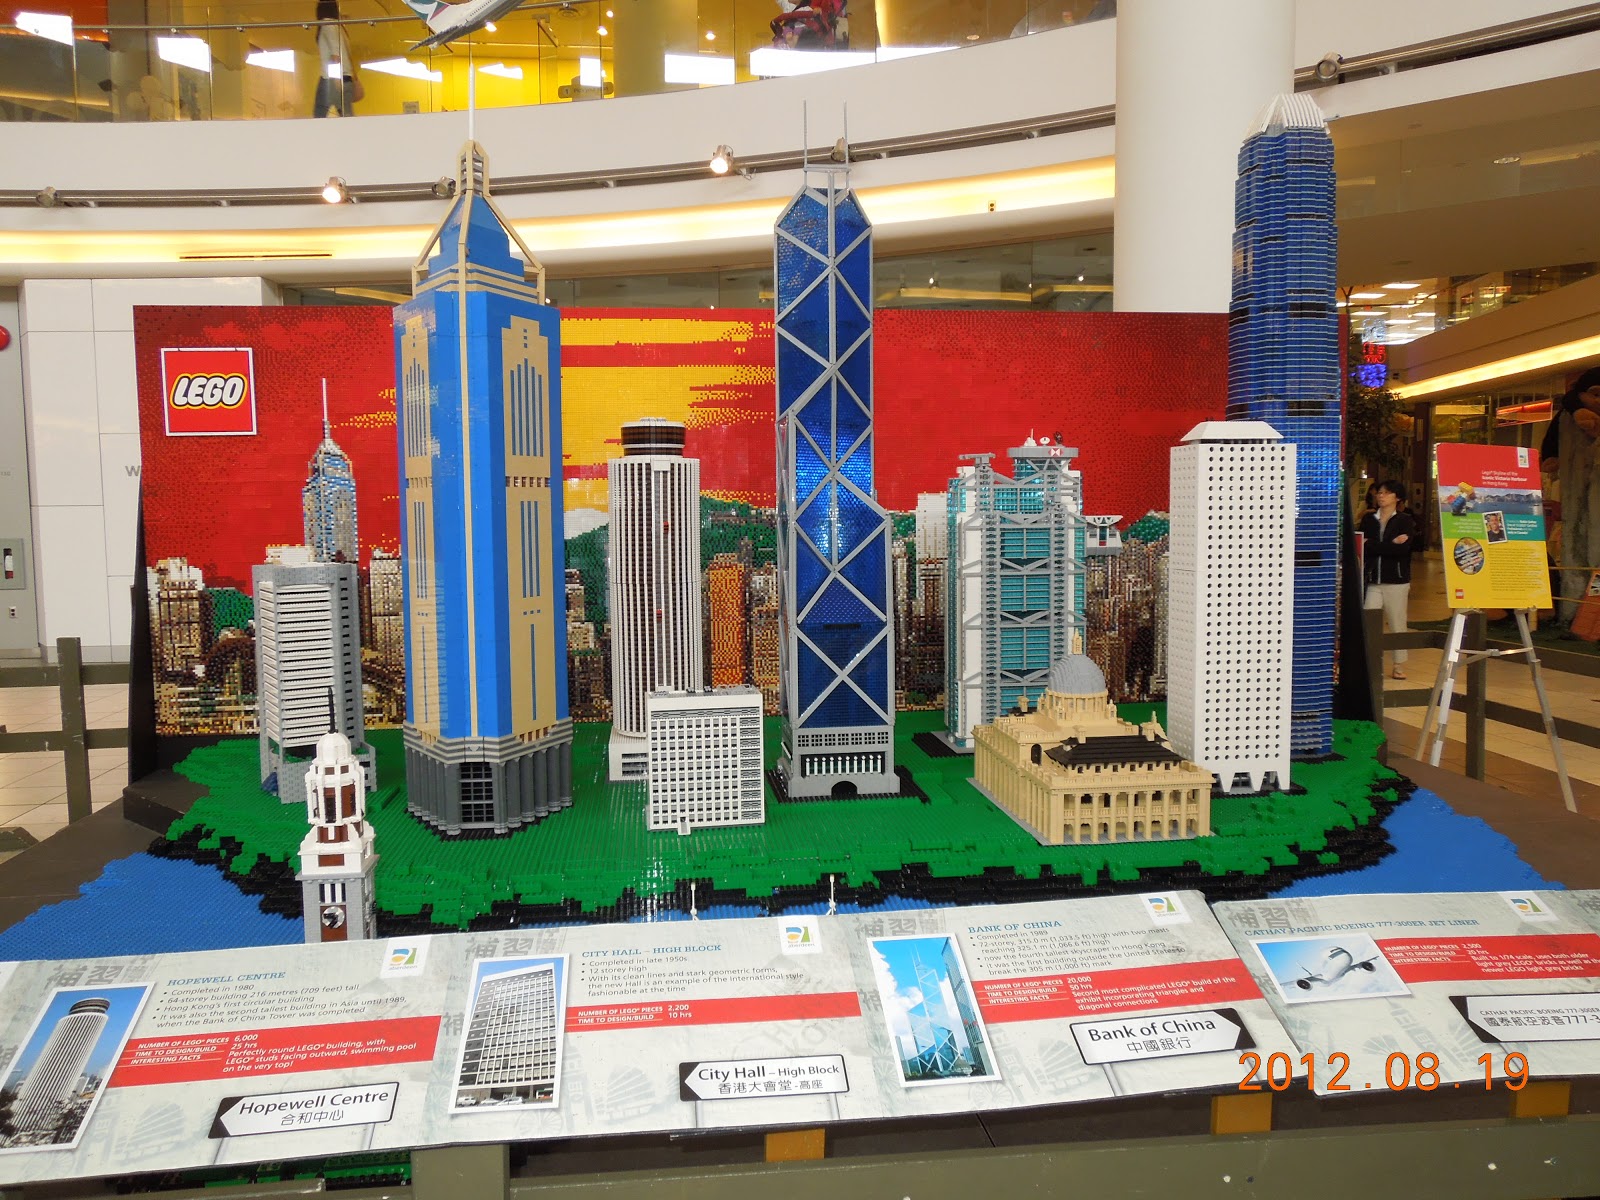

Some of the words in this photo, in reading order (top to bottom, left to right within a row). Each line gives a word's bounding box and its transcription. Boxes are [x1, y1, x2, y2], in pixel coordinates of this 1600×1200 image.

[171, 374, 247, 409] LEGO
[968, 925, 1001, 933] BANK
[1023, 920, 1062, 929] CHINA
[1244, 928, 1287, 936] CATHAY
[1289, 925, 1333, 934] PACIFIC
[1334, 922, 1375, 930] BOEING
[976, 931, 1019, 940] Completed
[582, 950, 609, 958] CITY
[612, 949, 642, 957] HALL
[652, 946, 682, 954] HIGH
[685, 945, 721, 953] BLOCK
[589, 959, 634, 968] Completed
[601, 966, 627, 975] storey
[628, 965, 647, 973] high
[167, 976, 233, 986] HOPEWELL
[237, 972, 286, 981] CENTRE
[708, 968, 750, 977] geometric
[1067, 976, 1092, 984] 20,000
[171, 987, 220, 996] Completed
[210, 993, 248, 1001] building
[268, 989, 298, 997] metres
[322, 985, 342, 993] feet)
[588, 988, 637, 997] fashionable
[1072, 988, 1100, 998] Second
[1121, 983, 1166, 994] complicated
[1192, 978, 1212, 986] build
[1075, 996, 1102, 1004] exhibit
[1103, 990, 1155, 1001] incorporating
[1155, 987, 1189, 998] triangles
[163, 1004, 188, 1012] Hong
[223, 1000, 242, 1008] first
[243, 998, 275, 1006] circular
[277, 995, 315, 1004] building
[226, 1007, 258, 1016] second
[260, 1005, 287, 1013] tallest
[289, 1003, 327, 1011] building
[385, 996, 407, 1004] 1989,
[578, 1009, 607, 1017] NUMBER
[667, 1004, 690, 1012] 2,200
[1078, 1002, 1112, 1011] diagonal
[1113, 998, 1159, 1008] connections
[202, 1017, 226, 1025] Bank
[227, 1016, 238, 1024] of
[241, 1014, 266, 1022] China
[269, 1012, 296, 1020] Tower
[317, 1006, 366, 1016] completed
[607, 1014, 654, 1022] DESIGN/BUILD
[1088, 1025, 1137, 1042] Bank
[1140, 1022, 1158, 1036] of
[1162, 1019, 1217, 1034] China
[137, 1041, 170, 1049] NUMBER
[234, 1033, 259, 1042] 6,000
[228, 1047, 266, 1057] Perfectly
[267, 1046, 295, 1055] round
[325, 1040, 364, 1050] building,
[366, 1038, 386, 1046] with
[1127, 1037, 1192, 1054] 中國銀行
[166, 1046, 217, 1055] DESIGN/BUILD
[255, 1054, 278, 1063] studs
[280, 1052, 307, 1061] facing
[309, 1049, 348, 1058] outward,
[350, 1045, 395, 1055] swimming
[396, 1042, 417, 1052] pool
[130, 1057, 178, 1065] INTERESTING
[237, 1064, 252, 1072] the
[254, 1063, 273, 1071] very
[274, 1061, 294, 1069] top!
[699, 1068, 730, 1082] City
[735, 1066, 765, 1078] Hall
[778, 1067, 805, 1078] High
[808, 1064, 840, 1074] Block
[239, 1095, 326, 1116] Hopewell
[330, 1092, 389, 1106] Centre
[281, 1109, 344, 1126] 合和中心
